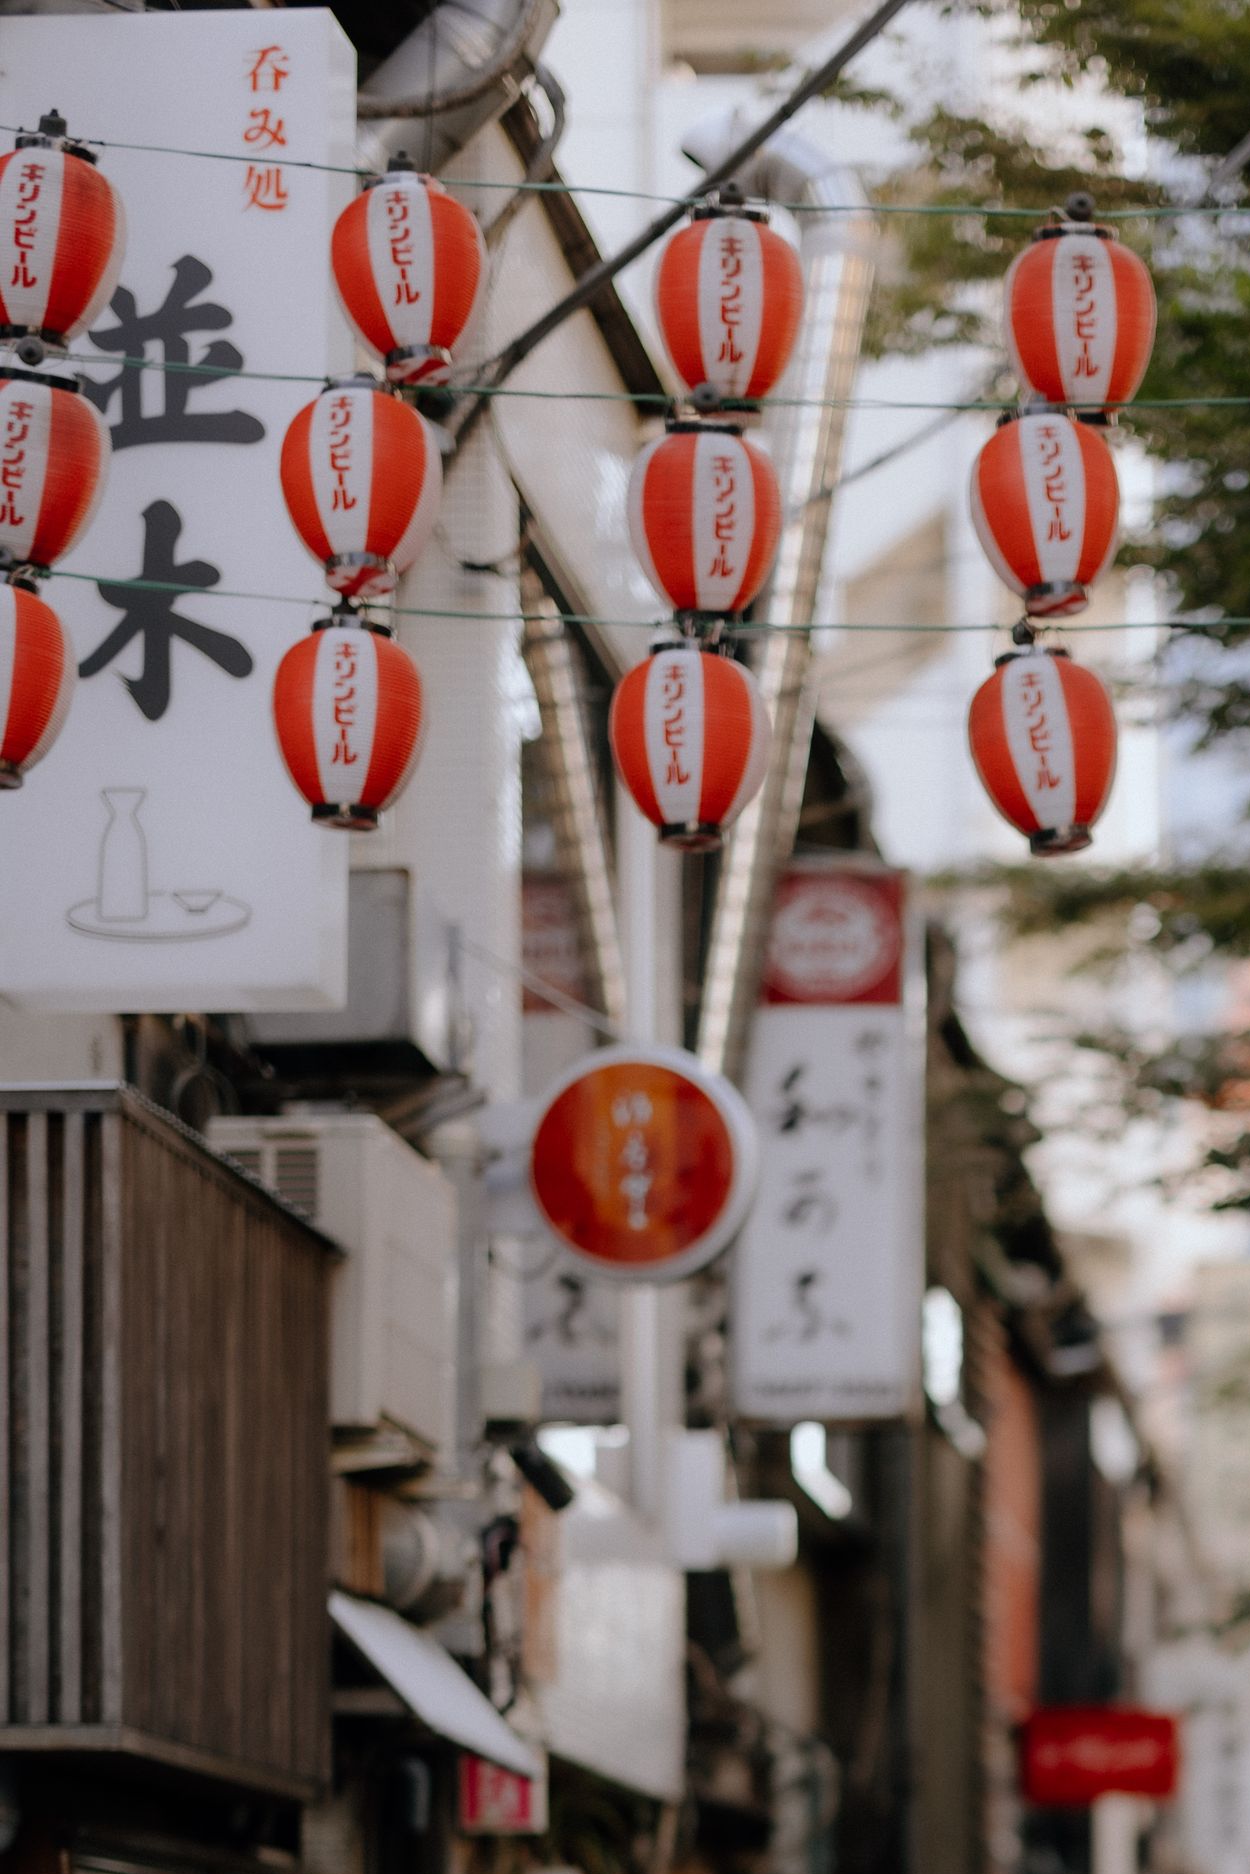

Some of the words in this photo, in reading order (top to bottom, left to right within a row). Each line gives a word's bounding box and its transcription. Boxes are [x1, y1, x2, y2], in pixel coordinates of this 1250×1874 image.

[242, 44, 290, 213] 呑み処
[10, 163, 46, 289] キリンビール
[384, 191, 421, 306] キリンビール
[715, 236, 746, 366] キリンビール
[1071, 253, 1102, 380] キリンビール
[0, 400, 33, 528] キリンビール
[79, 254, 266, 721] 並木
[328, 395, 358, 513] キリンビール
[706, 454, 736, 580] キリンビール
[1036, 424, 1074, 544] キリンビール
[331, 643, 359, 766] キリンビール
[661, 663, 690, 786] キリンビール
[1020, 670, 1063, 791] キリンビール
